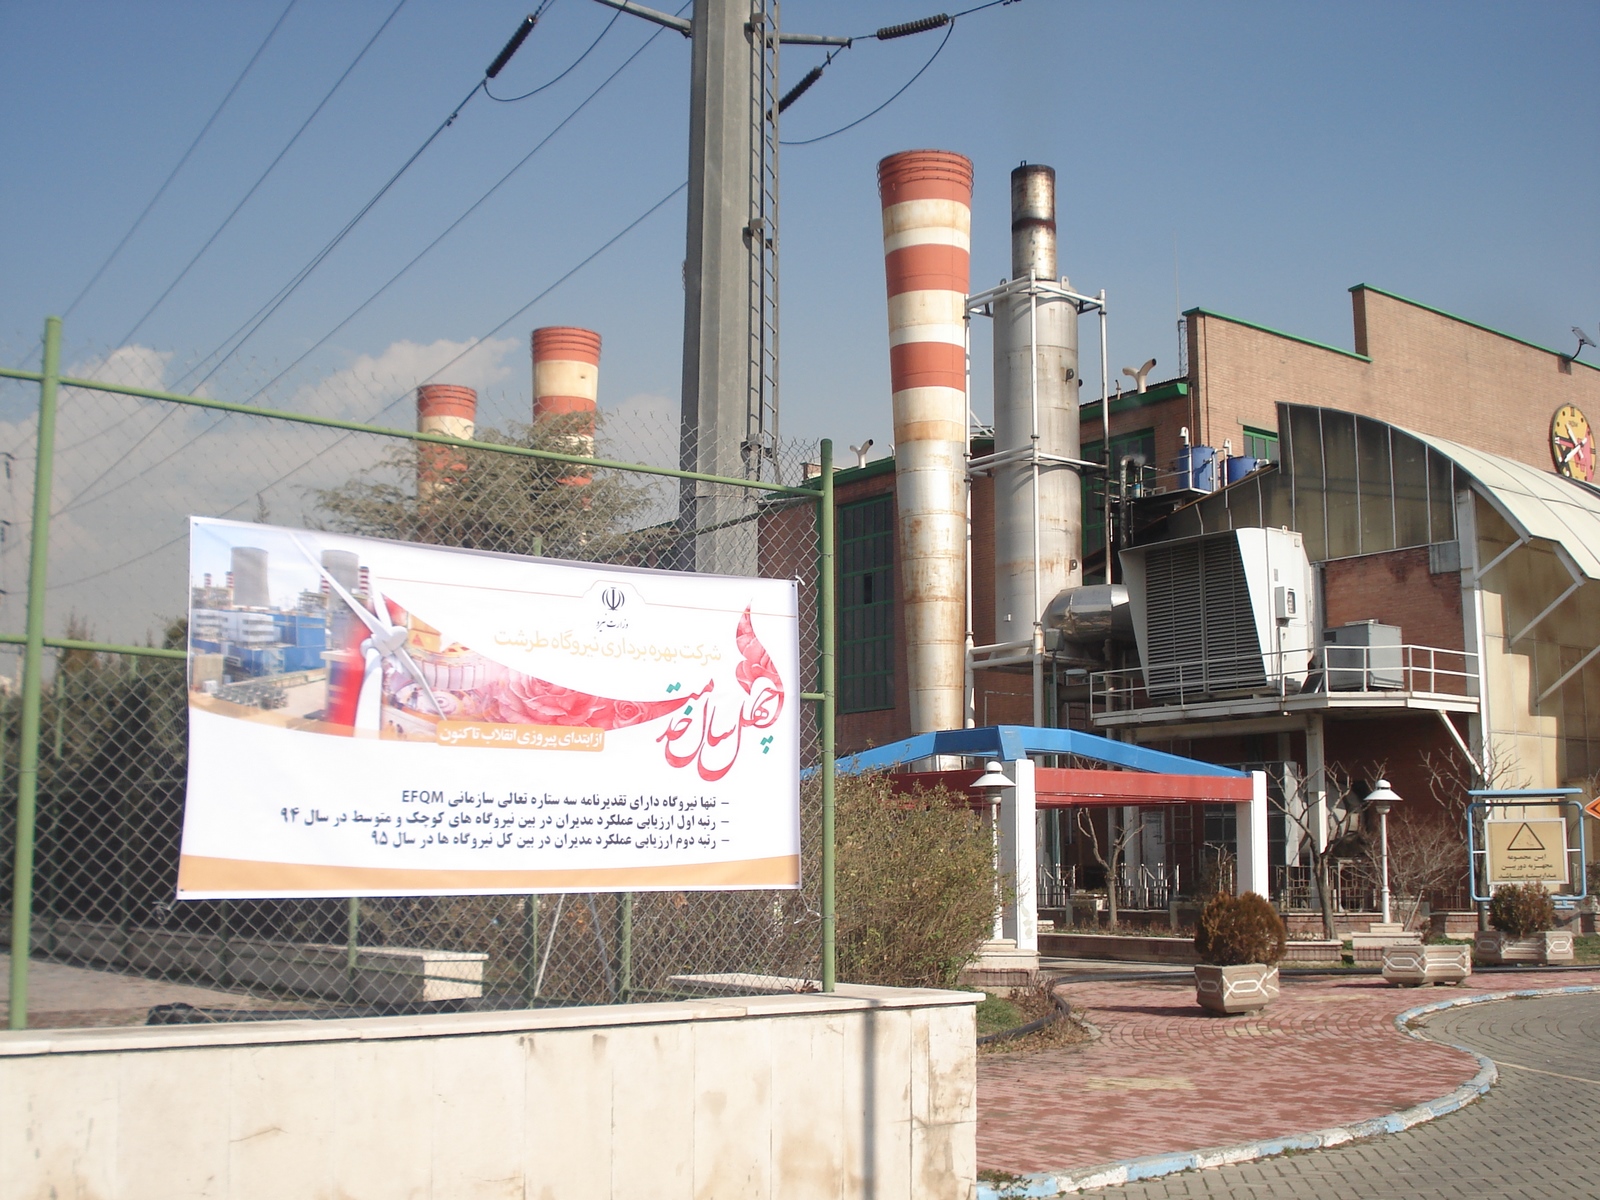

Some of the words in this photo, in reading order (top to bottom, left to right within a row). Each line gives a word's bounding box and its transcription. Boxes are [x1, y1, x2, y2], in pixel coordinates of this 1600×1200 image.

[606, 618, 629, 629] وزارت
[494, 629, 549, 652] طرشت
[551, 629, 599, 657] نیروگاه
[602, 637, 647, 660] برداری
[649, 645, 678, 664] بهره
[679, 643, 722, 666] شرکت
[439, 726, 473, 744] کنون
[471, 726, 480, 740] تا
[481, 727, 517, 745] انقلاب
[516, 729, 557, 749] پیروزی
[558, 730, 593, 747] ابتدای
[592, 732, 603, 748] از
[402, 790, 444, 804] EFQM
[448, 790, 495, 809] سازمانی
[497, 791, 528, 808] تعالی
[530, 792, 561, 809] ستاره
[563, 795, 578, 806] سه
[580, 793, 627, 811] تقدیرنامه
[629, 795, 660, 811] دارای
[662, 796, 698, 812] نیروگاه
[700, 796, 716, 811] تنها
[280, 807, 300, 823] ۹۴
[304, 809, 329, 826] سال
[333, 812, 348, 827] در
[351, 810, 392, 828] متوسط
[395, 815, 402, 828] و
[405, 811, 445, 829] کوچک
[448, 811, 472, 828] های
[475, 812, 515, 830] نیروگاه
[518, 816, 536, 829] بین
[539, 815, 553, 830] در
[555, 813, 594, 830] مدیران
[596, 813, 634, 830] عملکرد
[636, 814, 674, 831] ارزیابی
[676, 815, 695, 830] اول
[697, 815, 717, 831] رتبه
[371, 830, 389, 846] ۹۵
[393, 831, 416, 848] سال
[419, 835, 434, 849] در
[437, 832, 449, 845] ها
[452, 833, 493, 850] نیروگاه
[496, 832, 513, 848] کل
[516, 836, 535, 849] بین
[538, 835, 551, 849] در
[554, 833, 593, 850] مدیران
[595, 833, 632, 849] عملکرد
[634, 833, 673, 850] ارزیابی
[675, 834, 695, 849] دوم
[697, 834, 717, 850] رتبه
